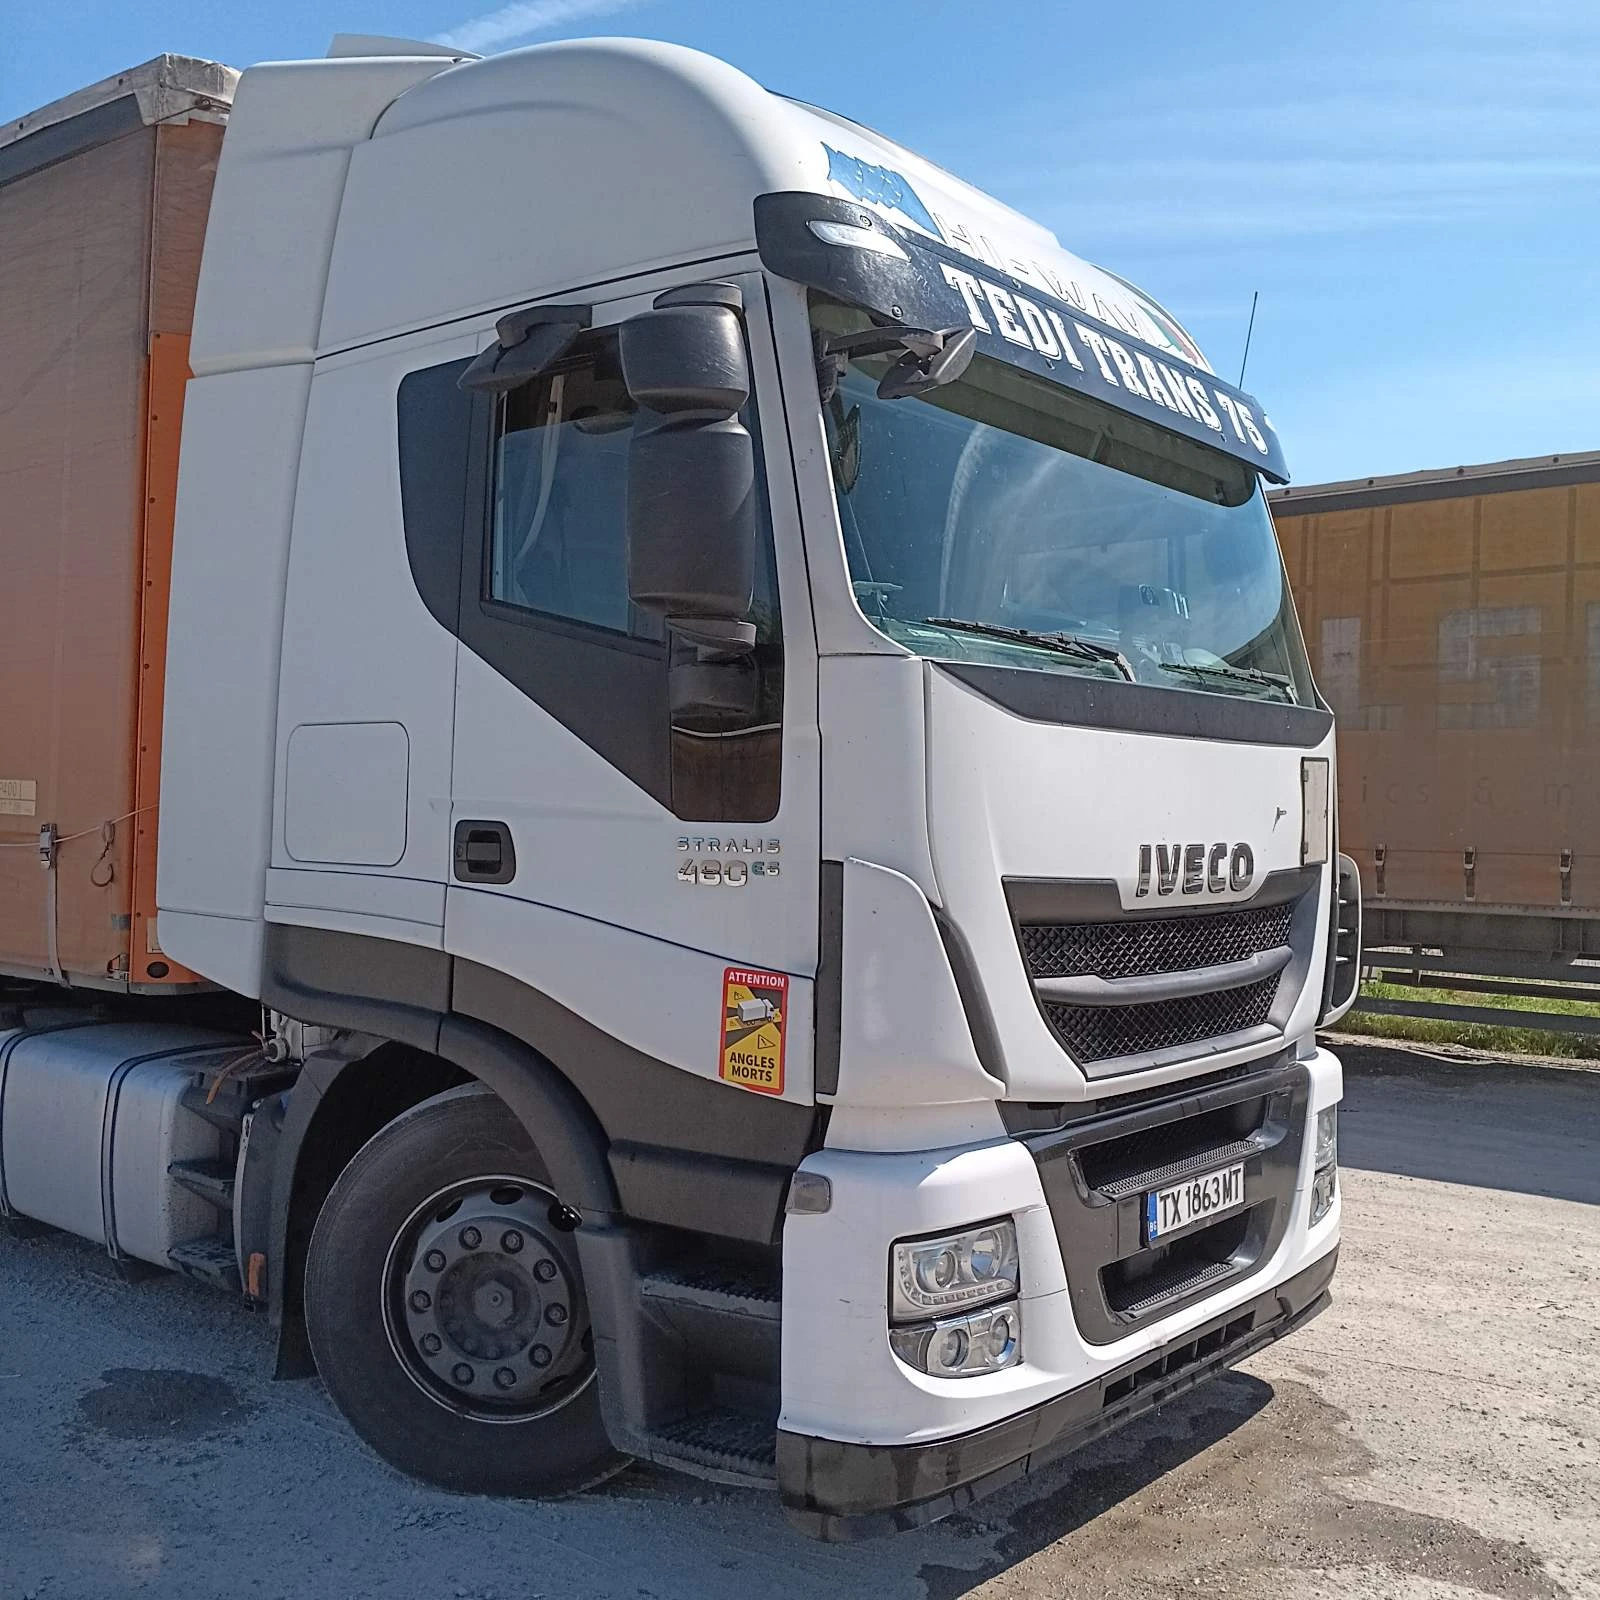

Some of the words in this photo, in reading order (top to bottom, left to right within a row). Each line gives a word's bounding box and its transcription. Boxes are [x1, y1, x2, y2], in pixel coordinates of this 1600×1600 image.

[939, 262, 1084, 372] TEDI
[1074, 322, 1222, 432] TRANS
[1213, 388, 1269, 456] 75
[677, 836, 780, 854] STRALIS
[677, 858, 748, 888] 480
[1136, 842, 1254, 897] IVECO
[728, 971, 785, 988] ATTENTION
[730, 1051, 775, 1071] ANGLES
[732, 1065, 773, 1082] MORTS
